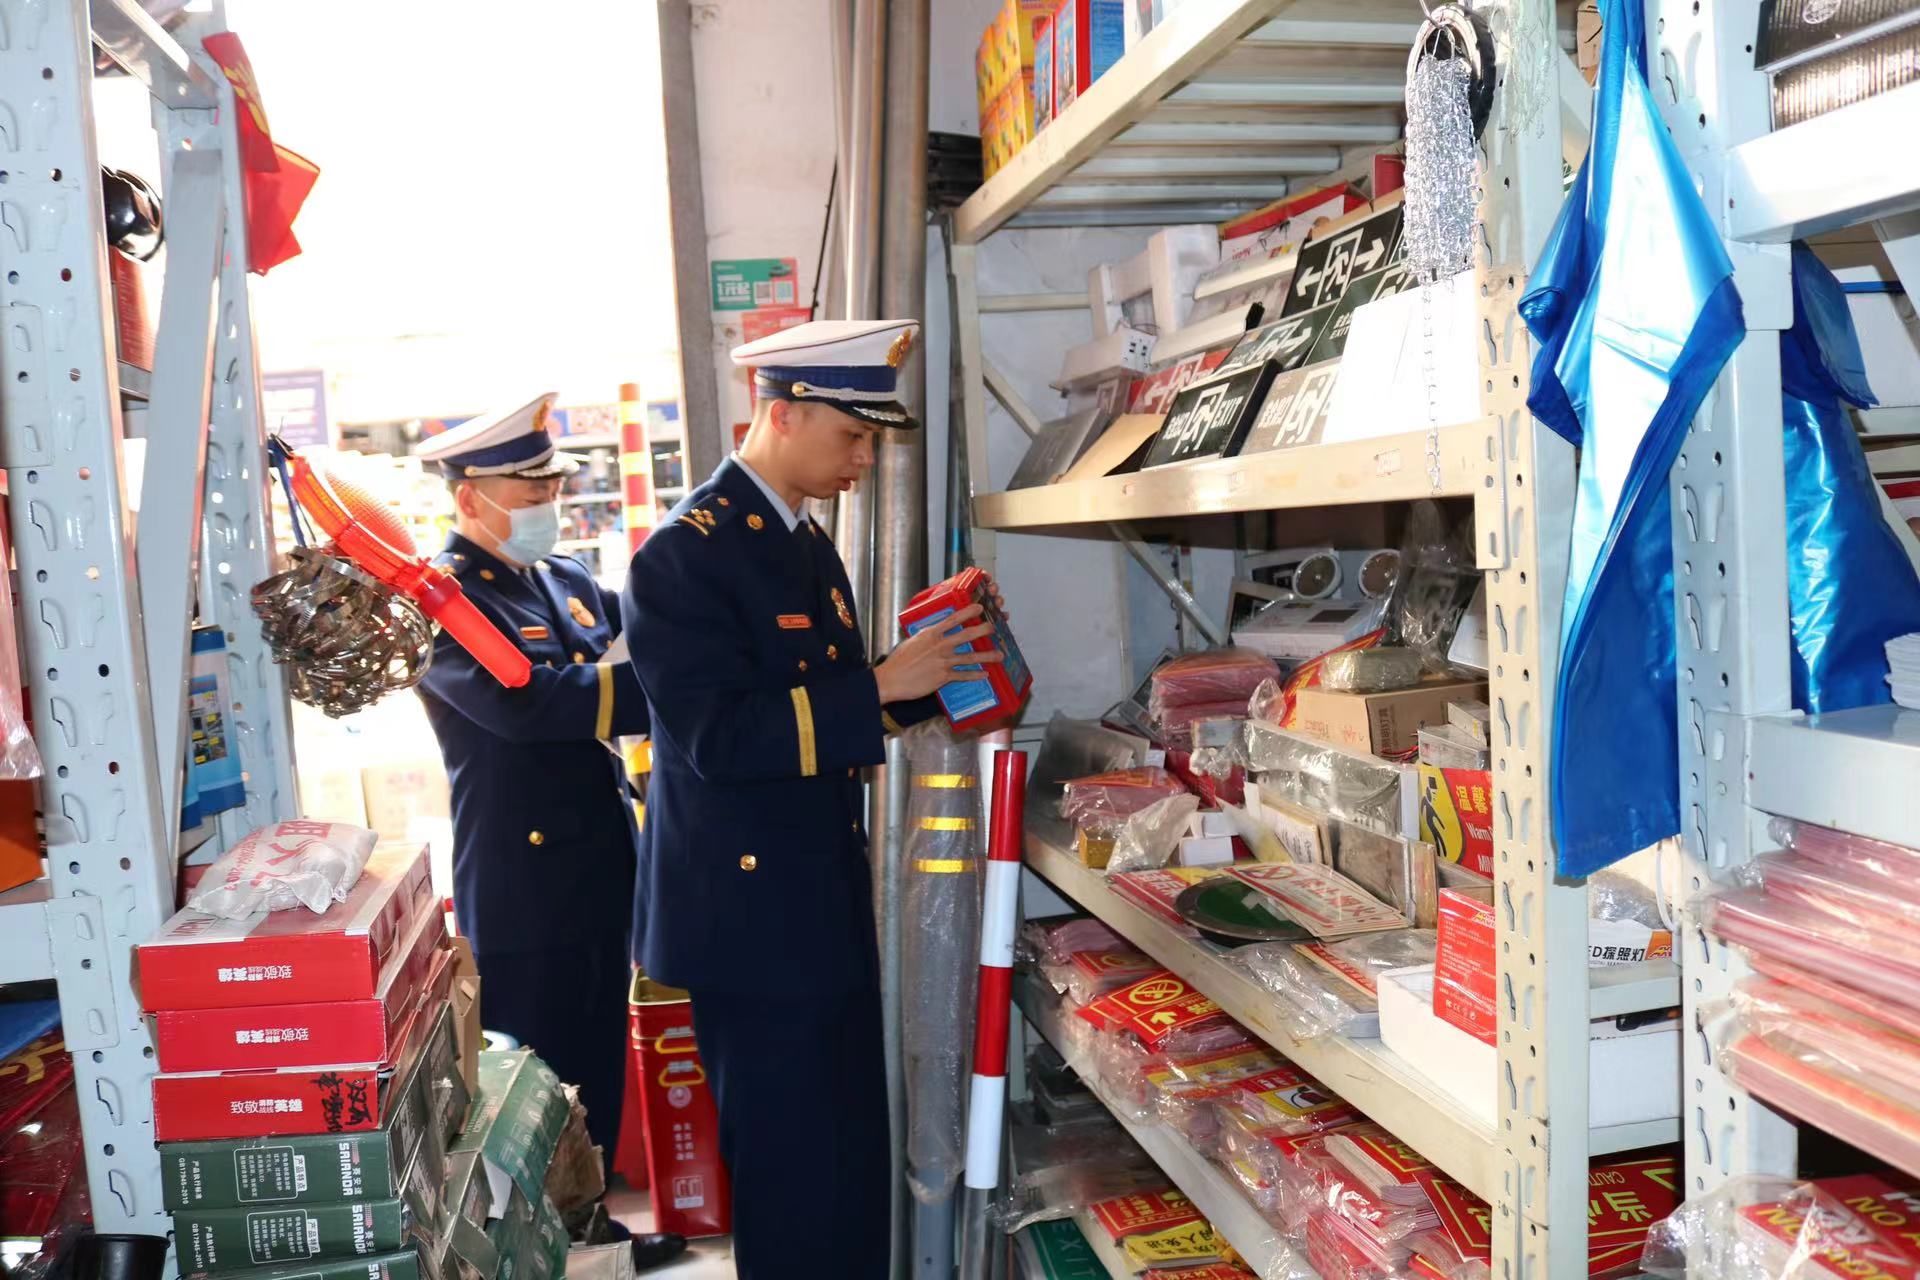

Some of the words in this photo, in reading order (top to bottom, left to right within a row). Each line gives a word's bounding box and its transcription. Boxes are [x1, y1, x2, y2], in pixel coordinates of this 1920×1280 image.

[1211, 396, 1245, 429] EXIT
[339, 1142, 354, 1197] SAIANDA
[1845, 1197, 1907, 1226] NO
[1052, 1222, 1096, 1278] EXIT
